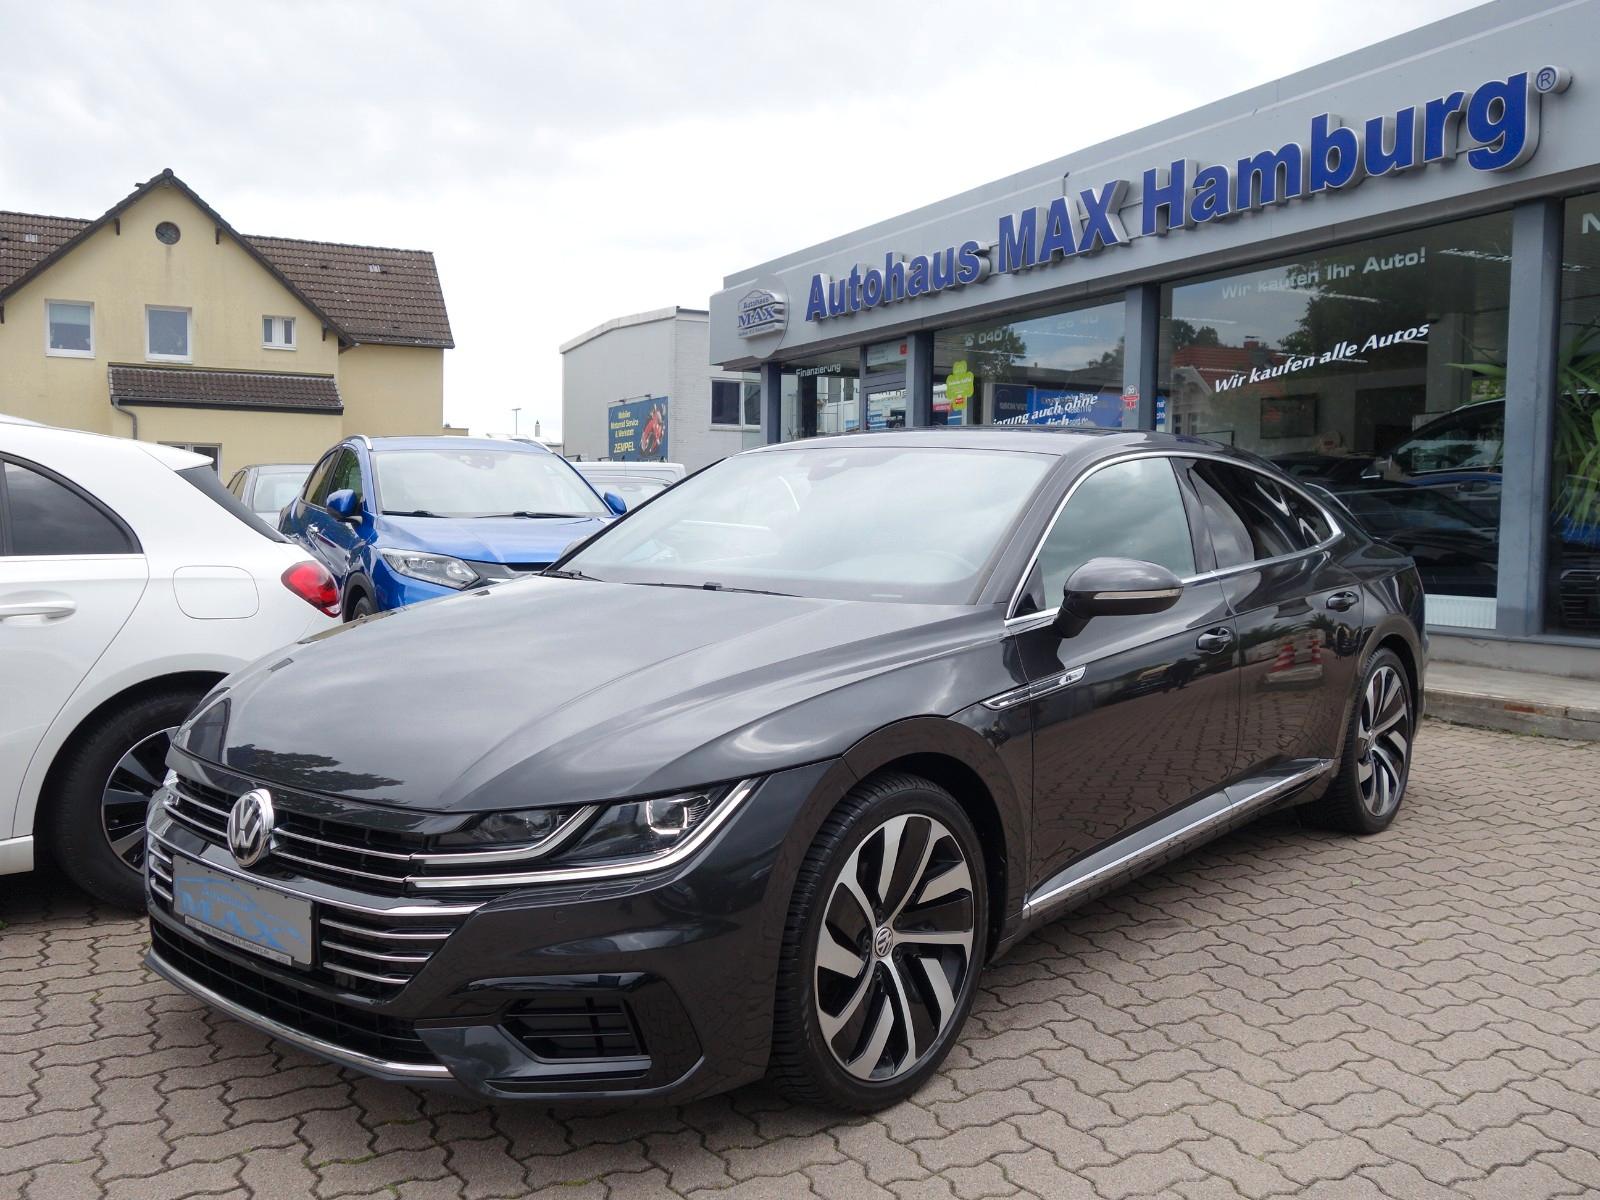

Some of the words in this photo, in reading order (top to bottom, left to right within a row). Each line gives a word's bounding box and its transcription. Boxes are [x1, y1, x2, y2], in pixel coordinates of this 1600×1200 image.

[804, 240, 983, 322] Autohaus
[998, 180, 1125, 274] MAX
[1221, 284, 1250, 299] Wir
[1258, 269, 1319, 293] kaufen
[1327, 263, 1355, 281] Ihr
[1362, 247, 1426, 274] Auto!
[737, 304, 775, 328] MAX
[796, 363, 841, 377] Finanzierung
[1215, 373, 1247, 393] Wir
[1249, 355, 1315, 384] kaufen
[1319, 341, 1358, 364] alle
[1361, 323, 1430, 352] Autos
[1031, 400, 1062, 420] auch
[1064, 395, 1098, 412] ohne
